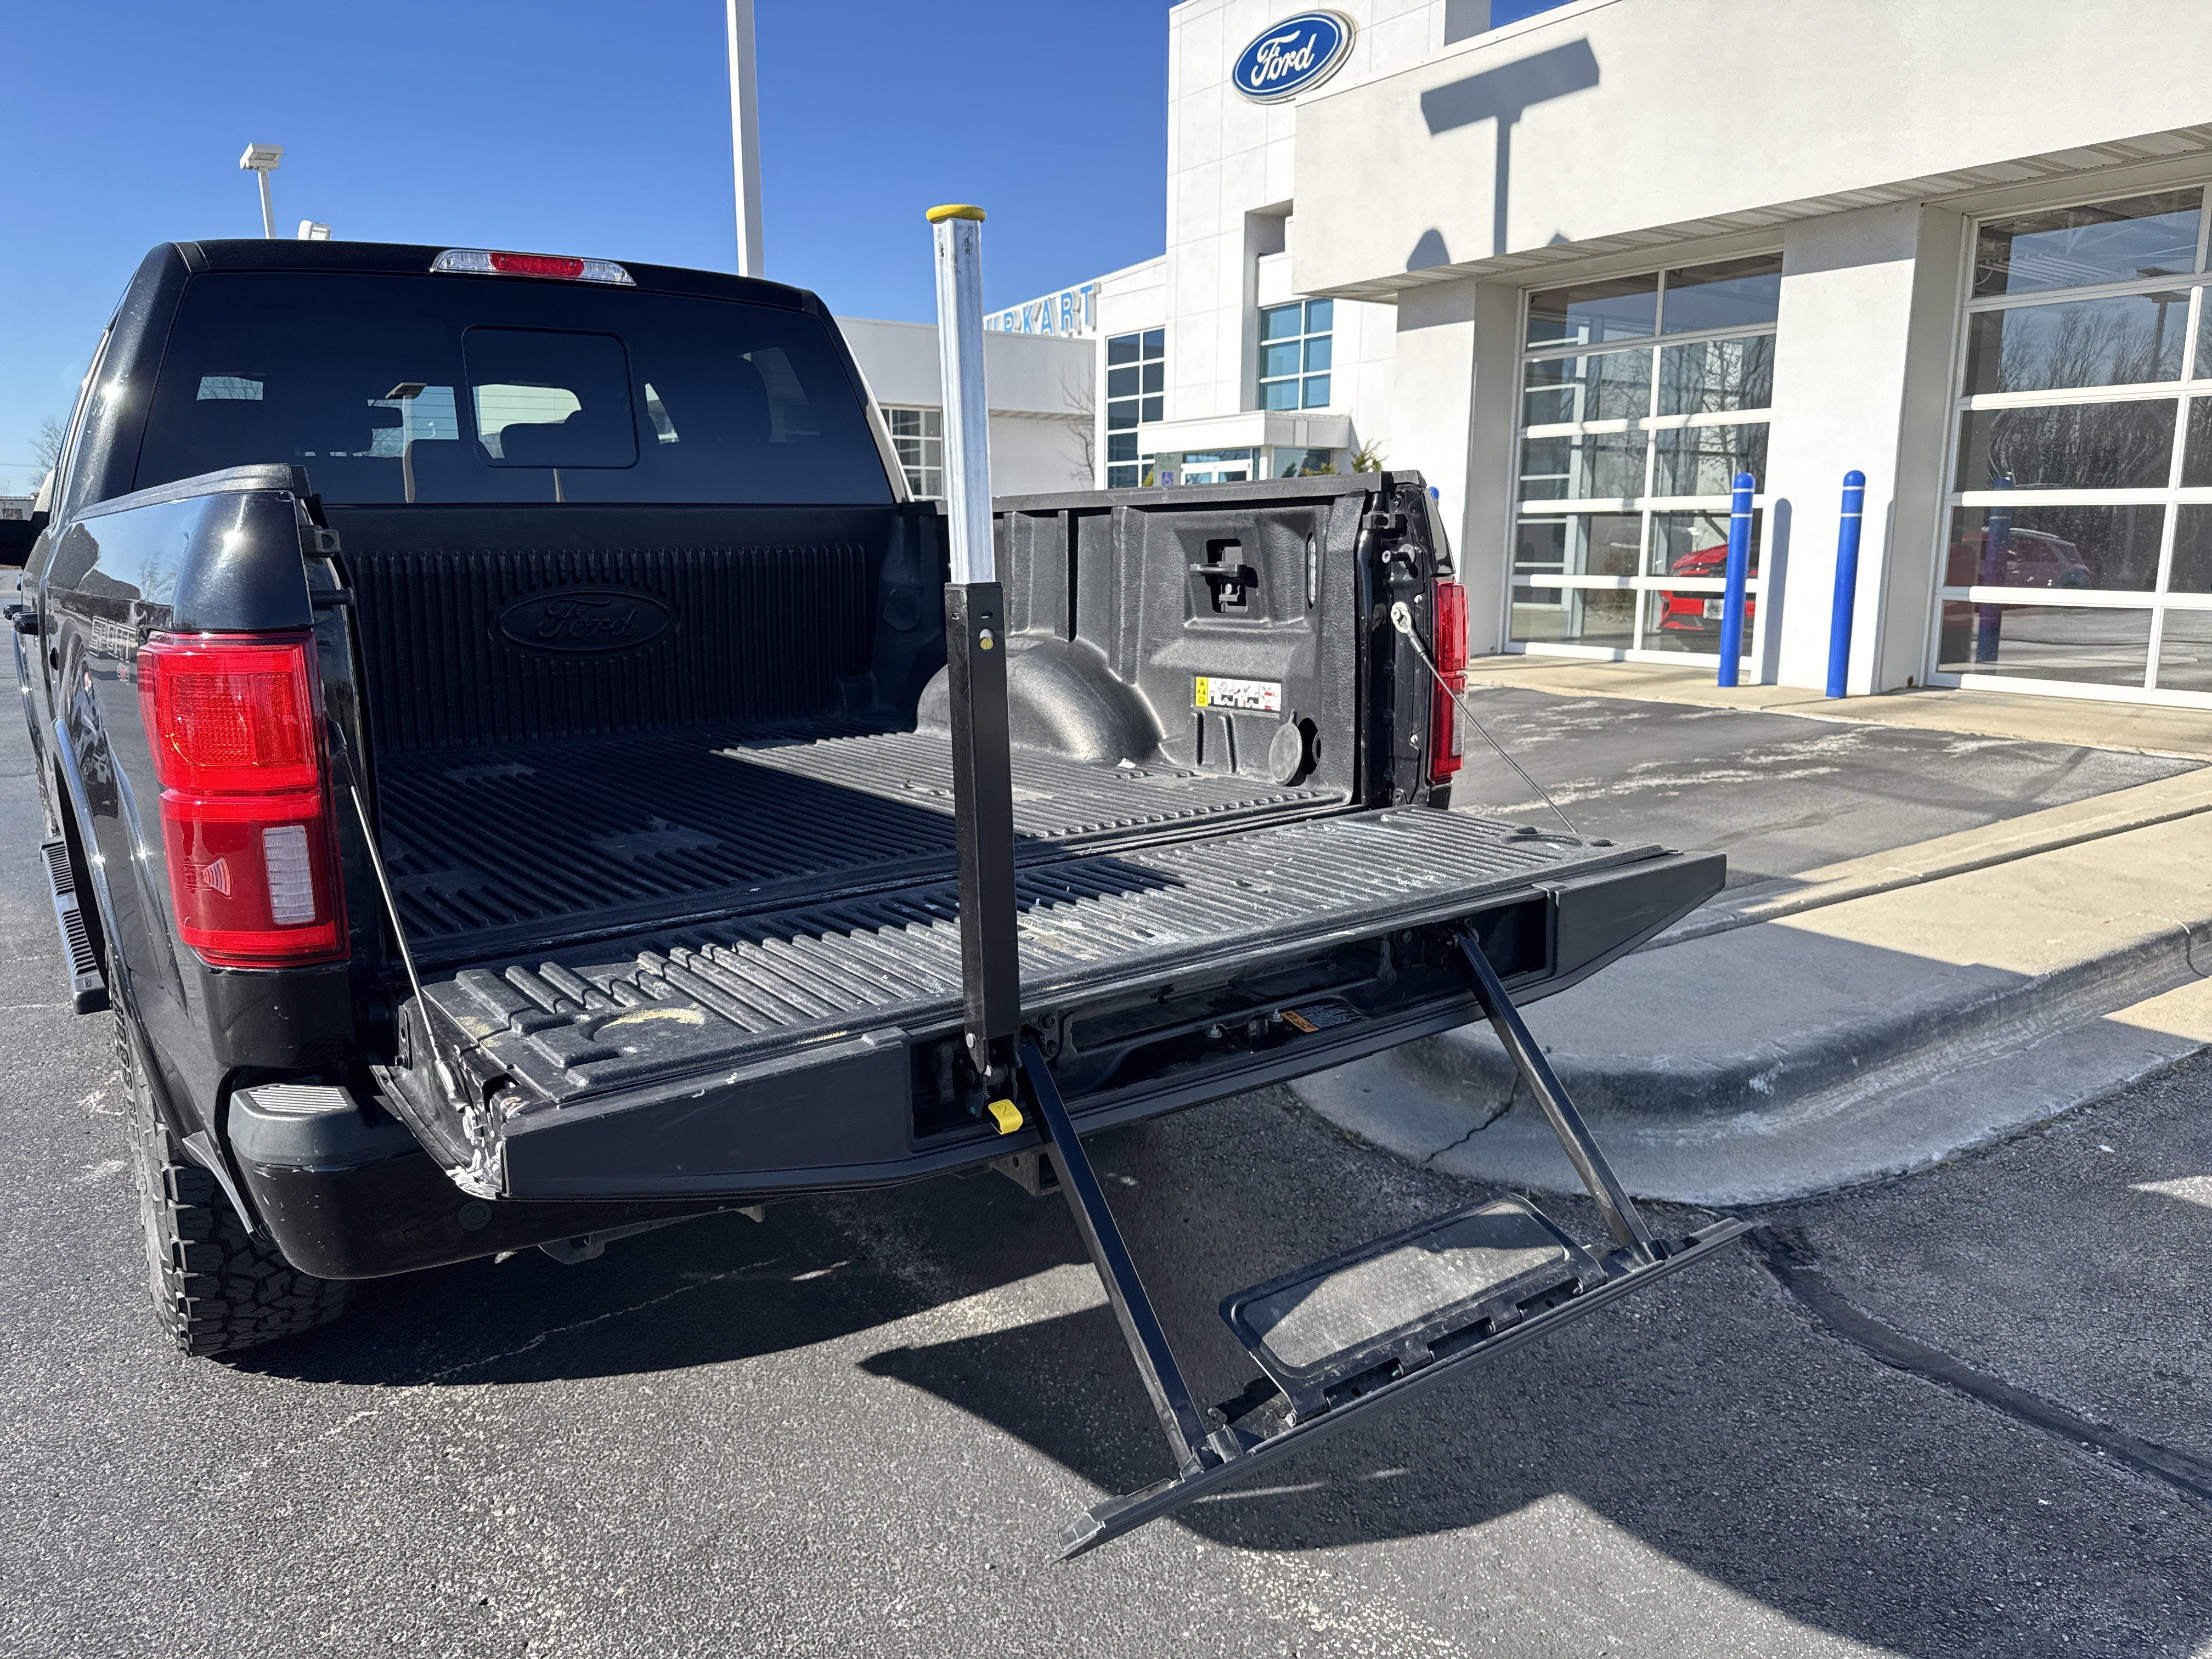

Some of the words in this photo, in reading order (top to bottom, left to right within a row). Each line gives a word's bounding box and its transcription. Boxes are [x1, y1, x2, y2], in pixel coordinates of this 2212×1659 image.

[1250, 30, 1317, 87] Ford
[88, 615, 137, 664] SPORT
[537, 597, 638, 639] Ford
[995, 1103, 1012, 1116] 2
